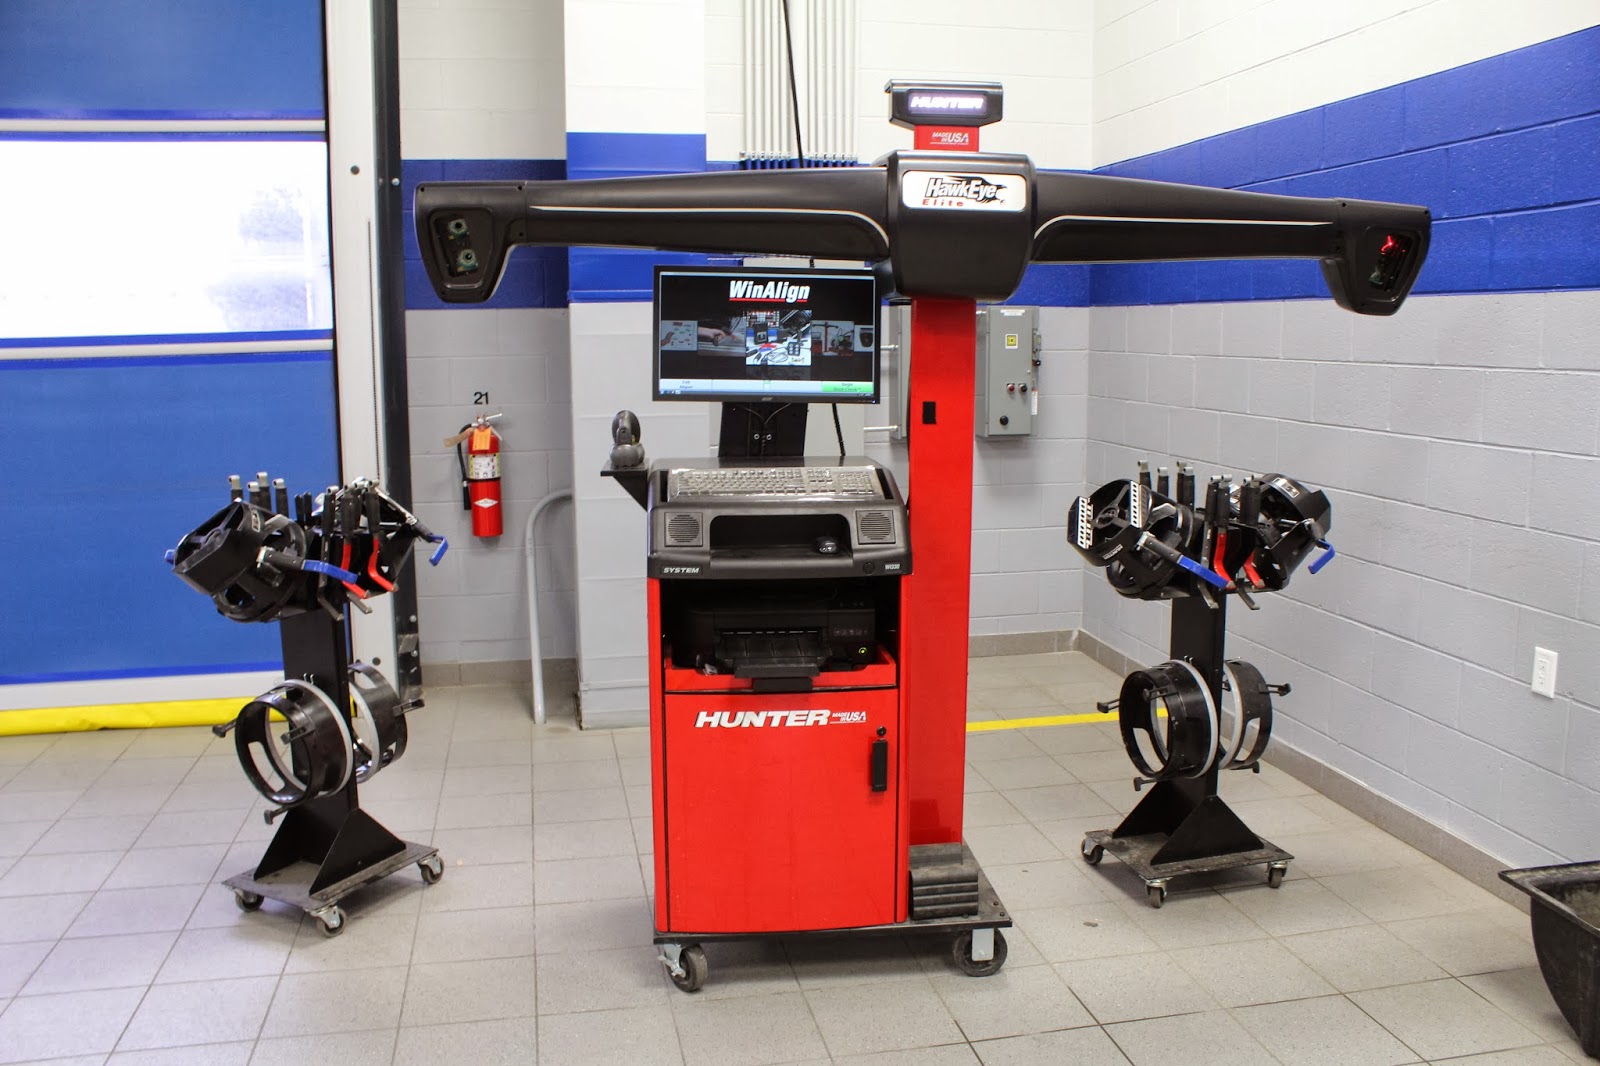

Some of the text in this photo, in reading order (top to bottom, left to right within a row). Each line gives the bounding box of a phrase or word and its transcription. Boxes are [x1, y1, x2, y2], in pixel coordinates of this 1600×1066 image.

[910, 96, 984, 109] HUNTER
[947, 132, 970, 143] USA
[924, 177, 998, 202] HawkEye
[922, 198, 964, 207] Elite
[729, 280, 811, 303] WinAlign
[473, 391, 489, 405] 21
[695, 709, 831, 728] HUNTER
[847, 711, 866, 721] USA
